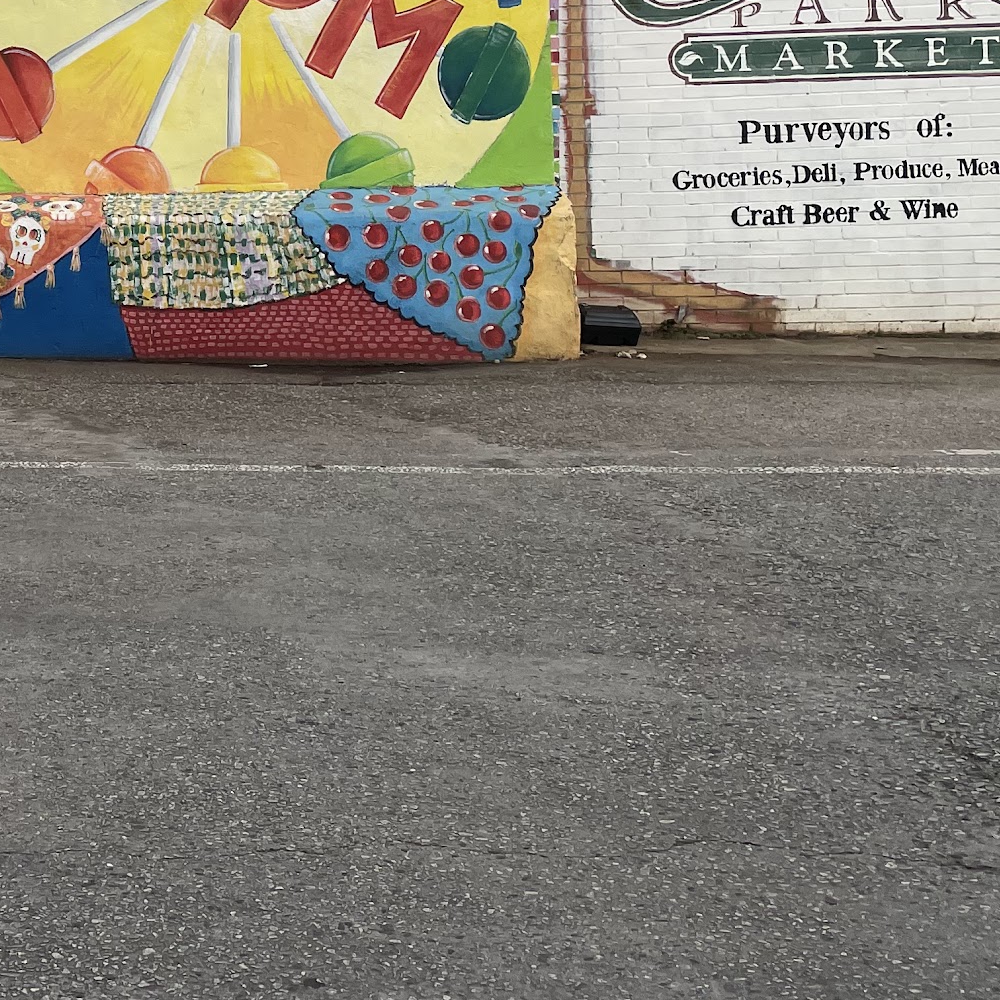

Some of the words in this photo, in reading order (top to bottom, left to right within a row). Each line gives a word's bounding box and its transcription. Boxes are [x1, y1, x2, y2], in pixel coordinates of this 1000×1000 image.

[713, 36, 1000, 73] MARKET
[738, 119, 890, 149] Purveyors
[916, 112, 953, 138] of:
[853, 159, 951, 181] Produce,
[731, 203, 795, 227] Craft
[803, 203, 860, 224] Beer
[869, 200, 891, 221] &
[898, 198, 959, 220] Wine
